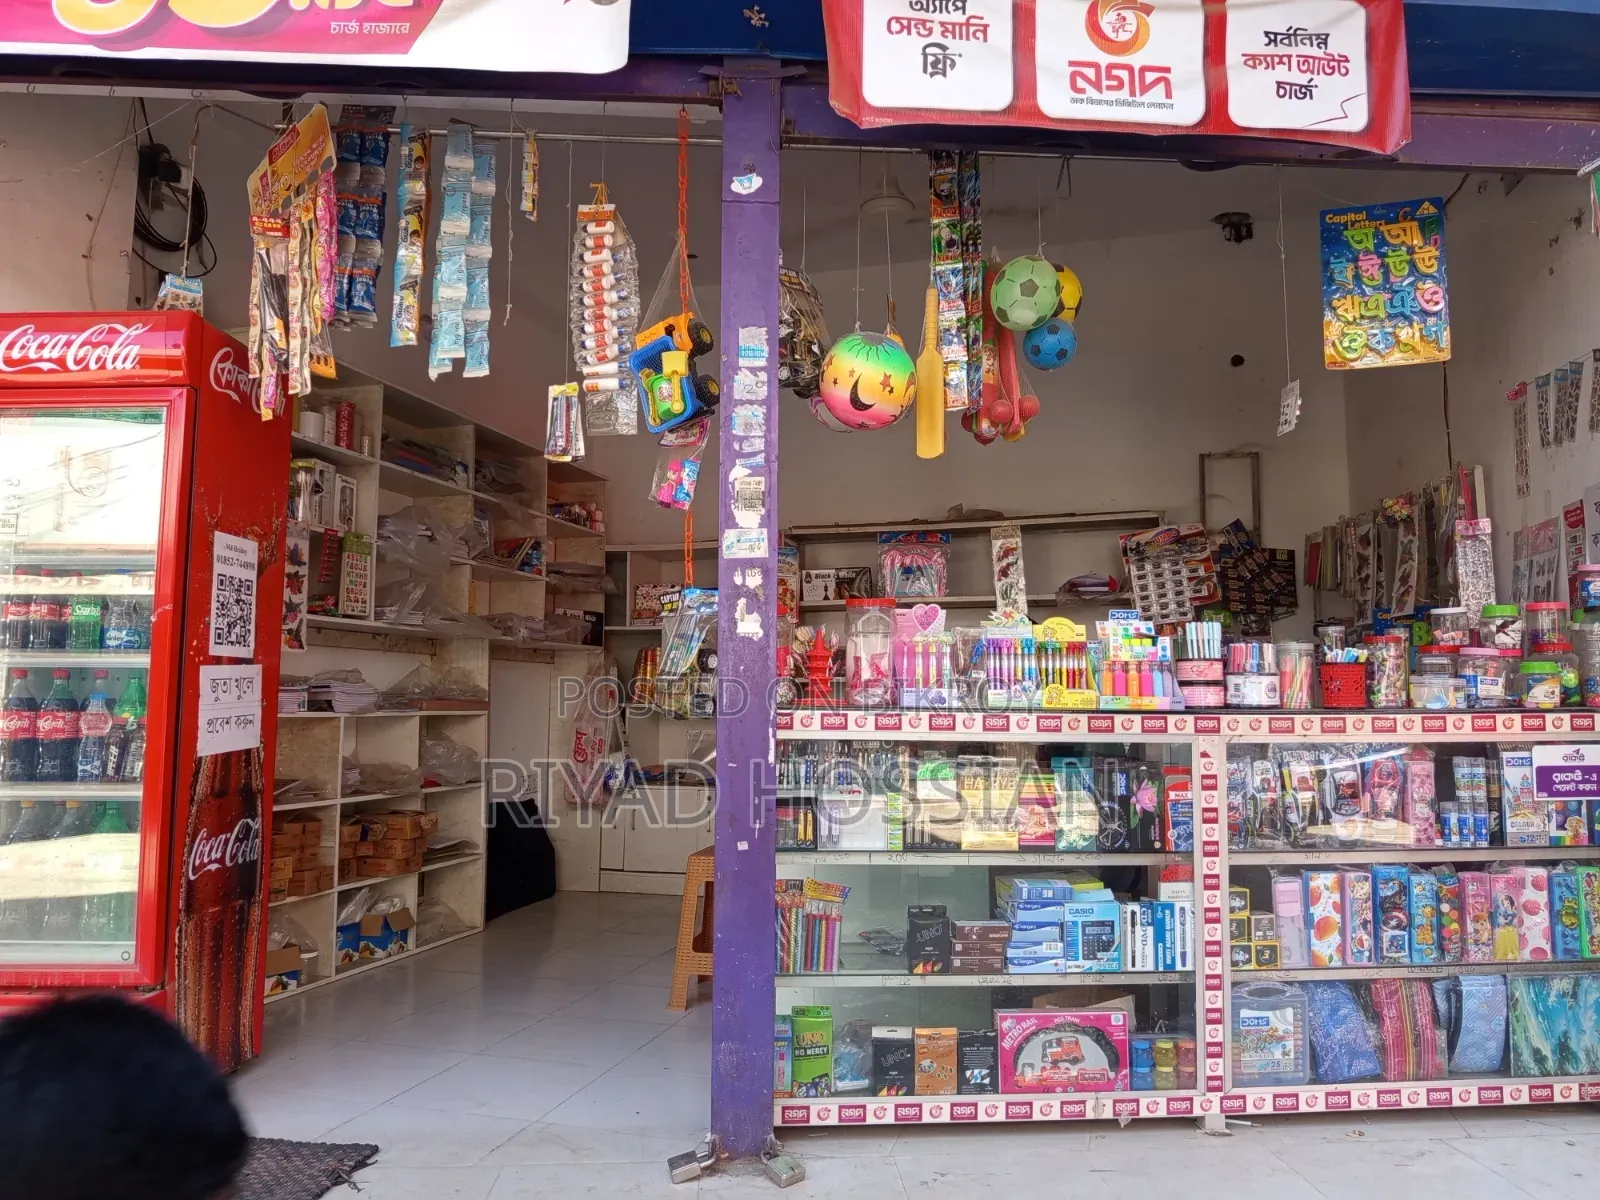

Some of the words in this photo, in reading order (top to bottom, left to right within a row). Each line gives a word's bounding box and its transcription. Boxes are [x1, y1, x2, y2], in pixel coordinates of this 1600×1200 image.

[330, 19, 360, 34] চার্জ
[362, 22, 411, 34] হাজারে
[886, 16, 934, 38] সেন্ড
[938, 15, 990, 43] মানি
[1263, 26, 1330, 50] সর্বনিম্ন
[1241, 53, 1293, 72] ক্যাশ
[1295, 51, 1350, 77] আউট
[1068, 60, 1172, 99] নগদ
[1086, 97, 1114, 107] বিভাগের
[1115, 98, 1145, 108] ডিজিটাল
[1146, 102, 1174, 110] লেনদেন
[1325, 210, 1367, 223] Capital
[0, 323, 154, 372] Coca-Cola
[814, 571, 832, 580] Black
[1111, 611, 1139, 621] DOMS
[209, 676, 233, 702] জুতা
[234, 674, 255, 701] খুলে
[206, 714, 233, 735] প্রবেশ
[234, 712, 256, 731] করুন
[1506, 757, 1532, 766] DOMS
[1526, 834, 1535, 842] 12
[188, 817, 262, 880] Coca-Cola
[916, 924, 943, 943] UNO
[1241, 1017, 1269, 1026] DOMS
[794, 1032, 826, 1046] UNO
[1001, 1026, 1022, 1051] METRO
[1021, 1016, 1038, 1031] RAIL
[794, 1048, 804, 1056] NO
[806, 1046, 828, 1056] MERCY
[881, 1049, 907, 1067] UNO
[1271, 1060, 1281, 1068] 25
